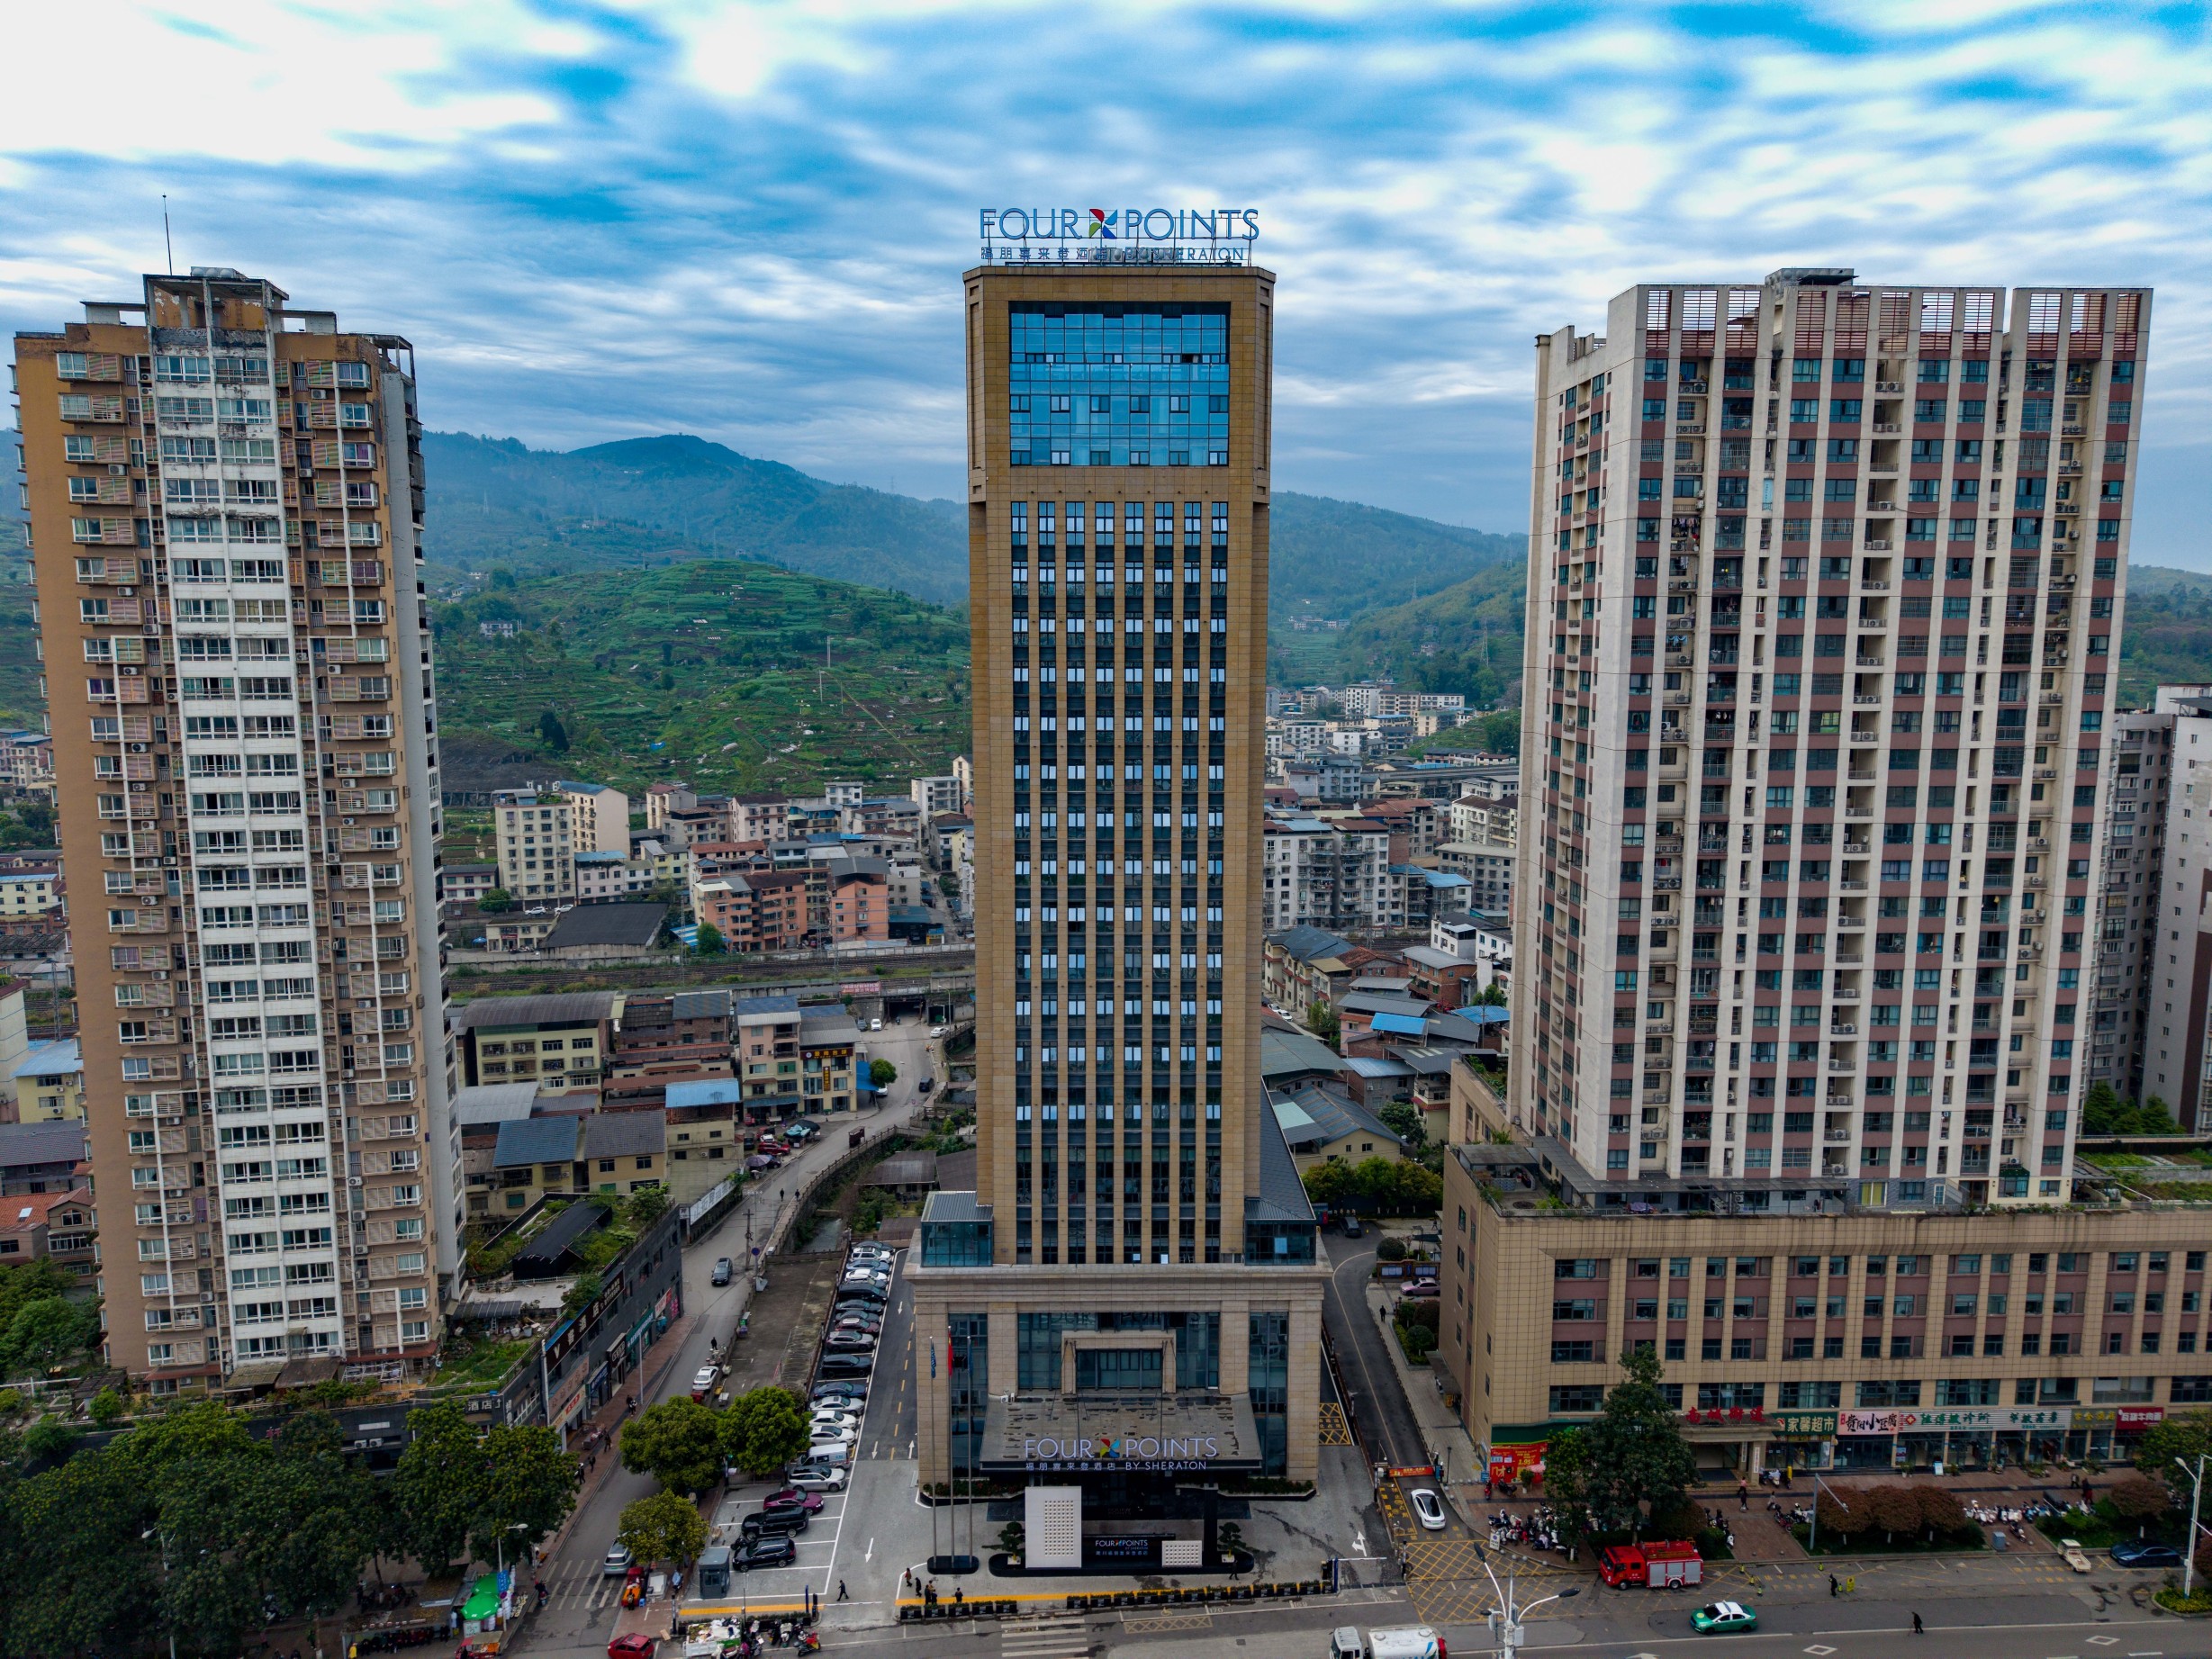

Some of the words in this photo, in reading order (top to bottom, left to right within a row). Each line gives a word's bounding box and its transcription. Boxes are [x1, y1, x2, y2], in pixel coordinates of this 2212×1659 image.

[980, 208, 1083, 240] FOUR
[1125, 208, 1259, 240] POINTS
[1787, 1416, 1835, 1432] 家馨超市
[1846, 1413, 1898, 1432] 贵阳小豆腐
[1025, 1438, 1095, 1458] FOUR
[1125, 1437, 1217, 1458] POINTS
[1025, 1462, 1115, 1471] 福朋喜来登酒店
[1125, 1461, 1140, 1471] BY
[1145, 1461, 1206, 1471] SHERATON
